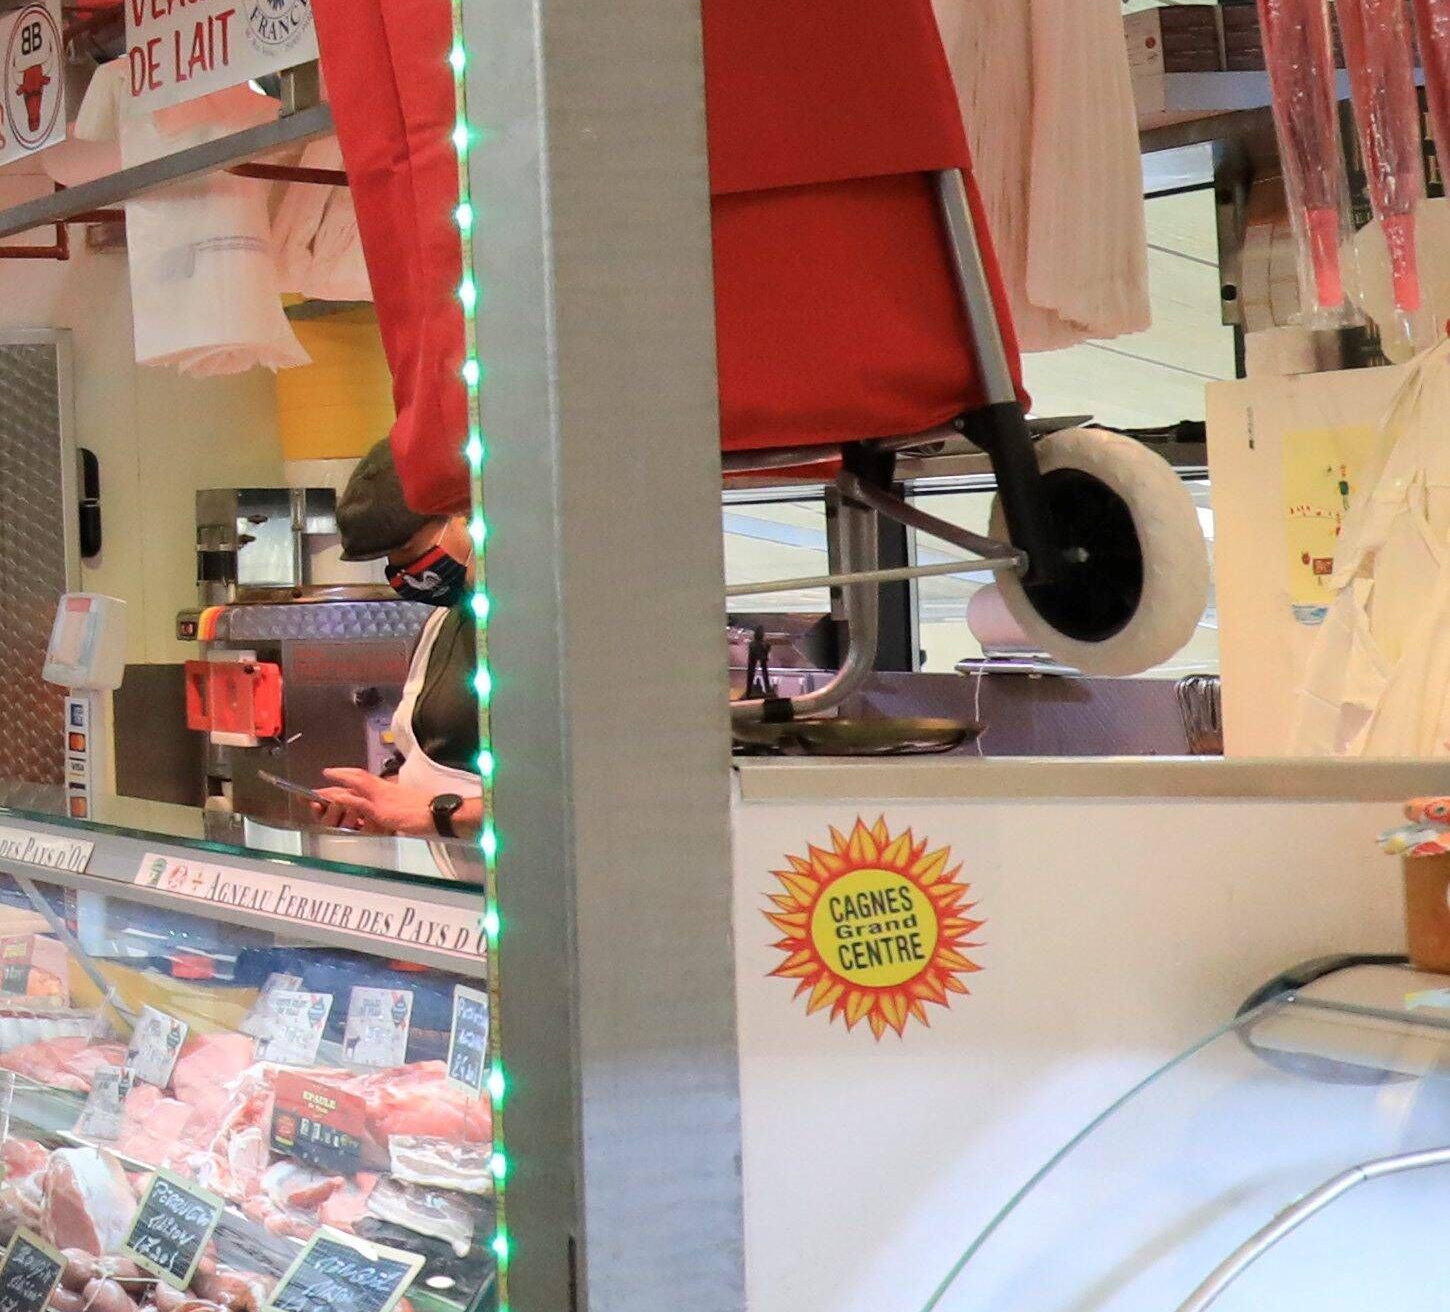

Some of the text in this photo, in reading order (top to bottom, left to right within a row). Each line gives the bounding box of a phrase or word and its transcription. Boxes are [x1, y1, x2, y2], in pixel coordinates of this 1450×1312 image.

[130, 9, 235, 96] DE LAIT
[22, 837, 54, 868] PAYS
[205, 872, 450, 949] AGNEAU FERMIER DES PAYS
[829, 885, 913, 923] CAGNES
[836, 914, 918, 939] Grand
[838, 932, 925, 970] CENTRE
